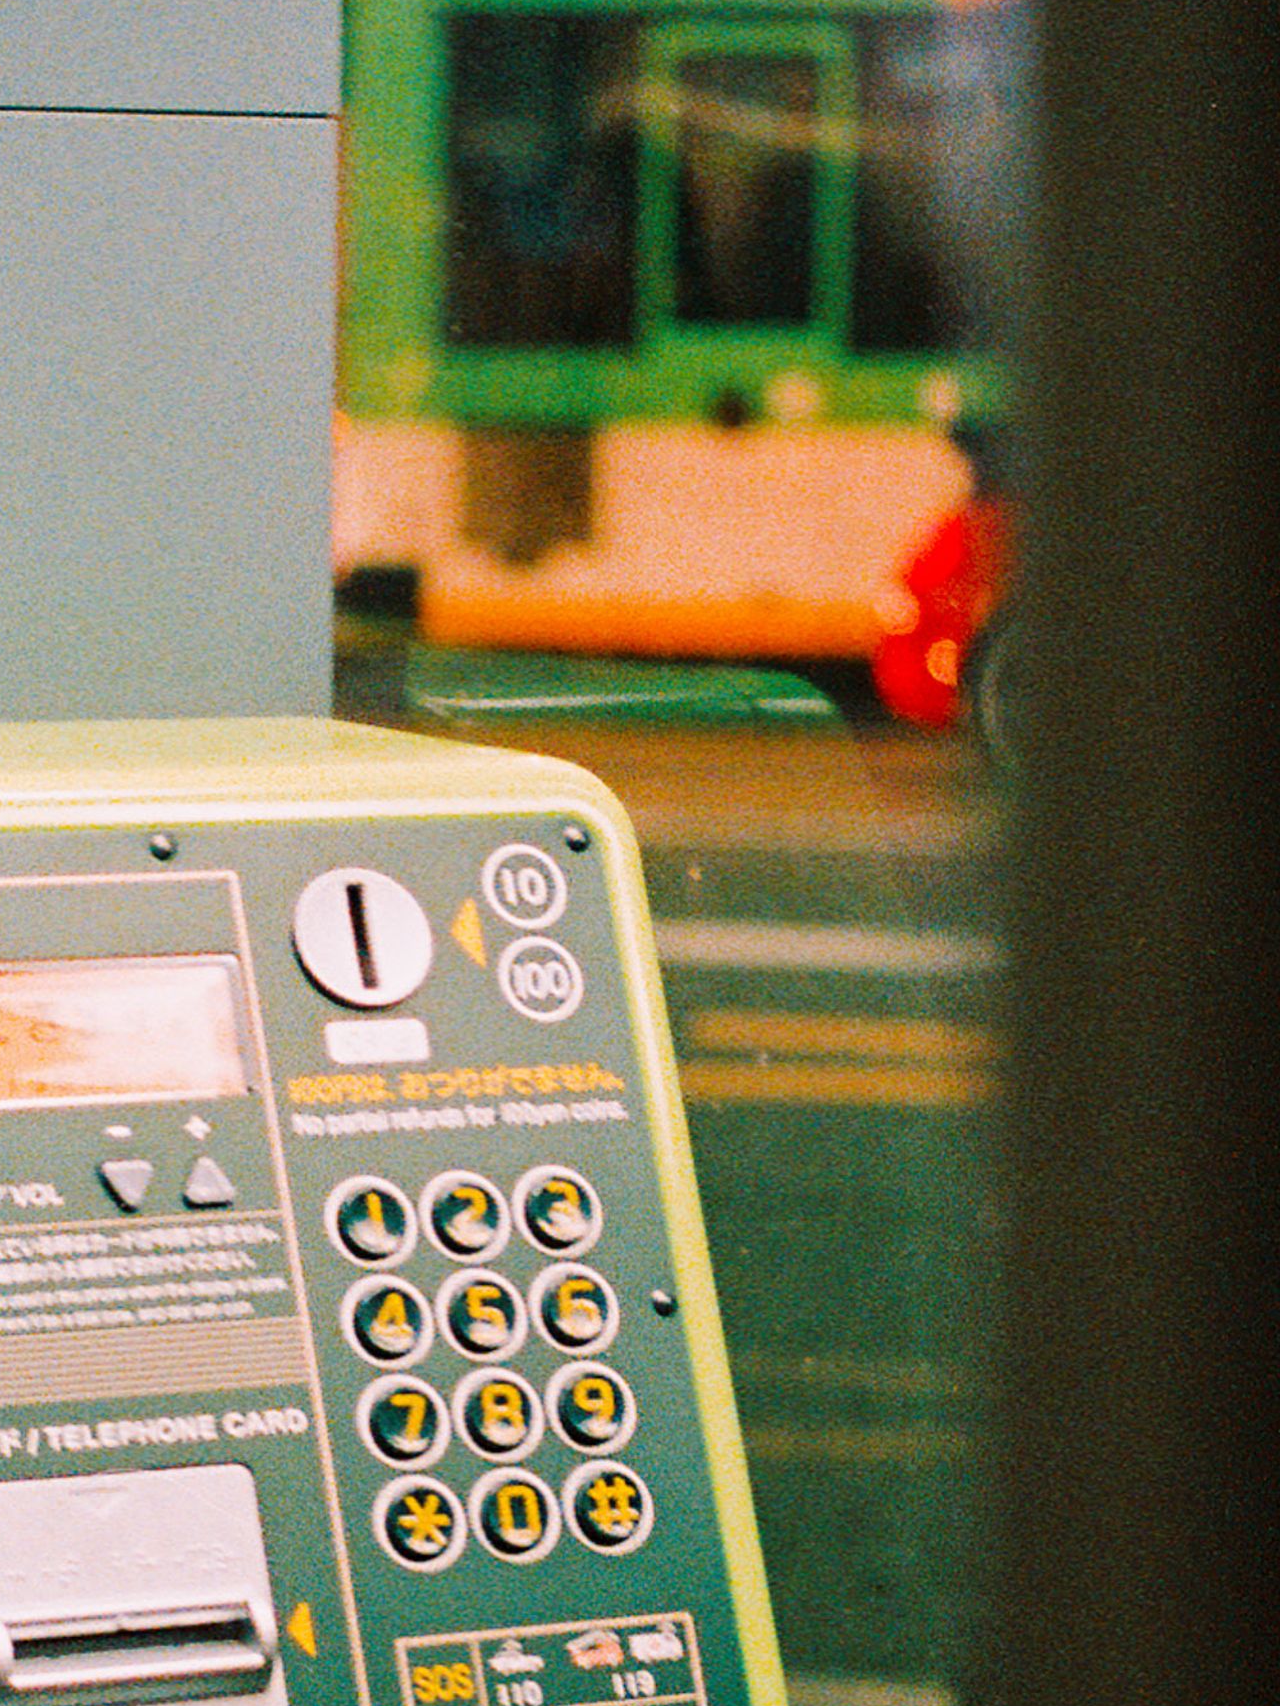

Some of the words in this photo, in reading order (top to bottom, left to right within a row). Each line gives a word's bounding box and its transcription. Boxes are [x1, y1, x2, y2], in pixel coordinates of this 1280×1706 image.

[499, 867, 548, 906] 10
[512, 961, 570, 999] 100
[450, 1183, 496, 1245] 2
[540, 1178, 585, 1239] 3
[371, 1293, 416, 1349] 4
[466, 1286, 511, 1346] 5
[558, 1279, 602, 1339] 6
[43, 1413, 219, 1451] TELEPHONE
[221, 1407, 309, 1439] CARD
[390, 1393, 430, 1449] 7
[481, 1382, 525, 1443] 8
[573, 1377, 617, 1436] 9
[497, 1483, 543, 1547] 0
[587, 1476, 642, 1536] #
[413, 1662, 475, 1703] SOS
[611, 1669, 657, 1699] 119
